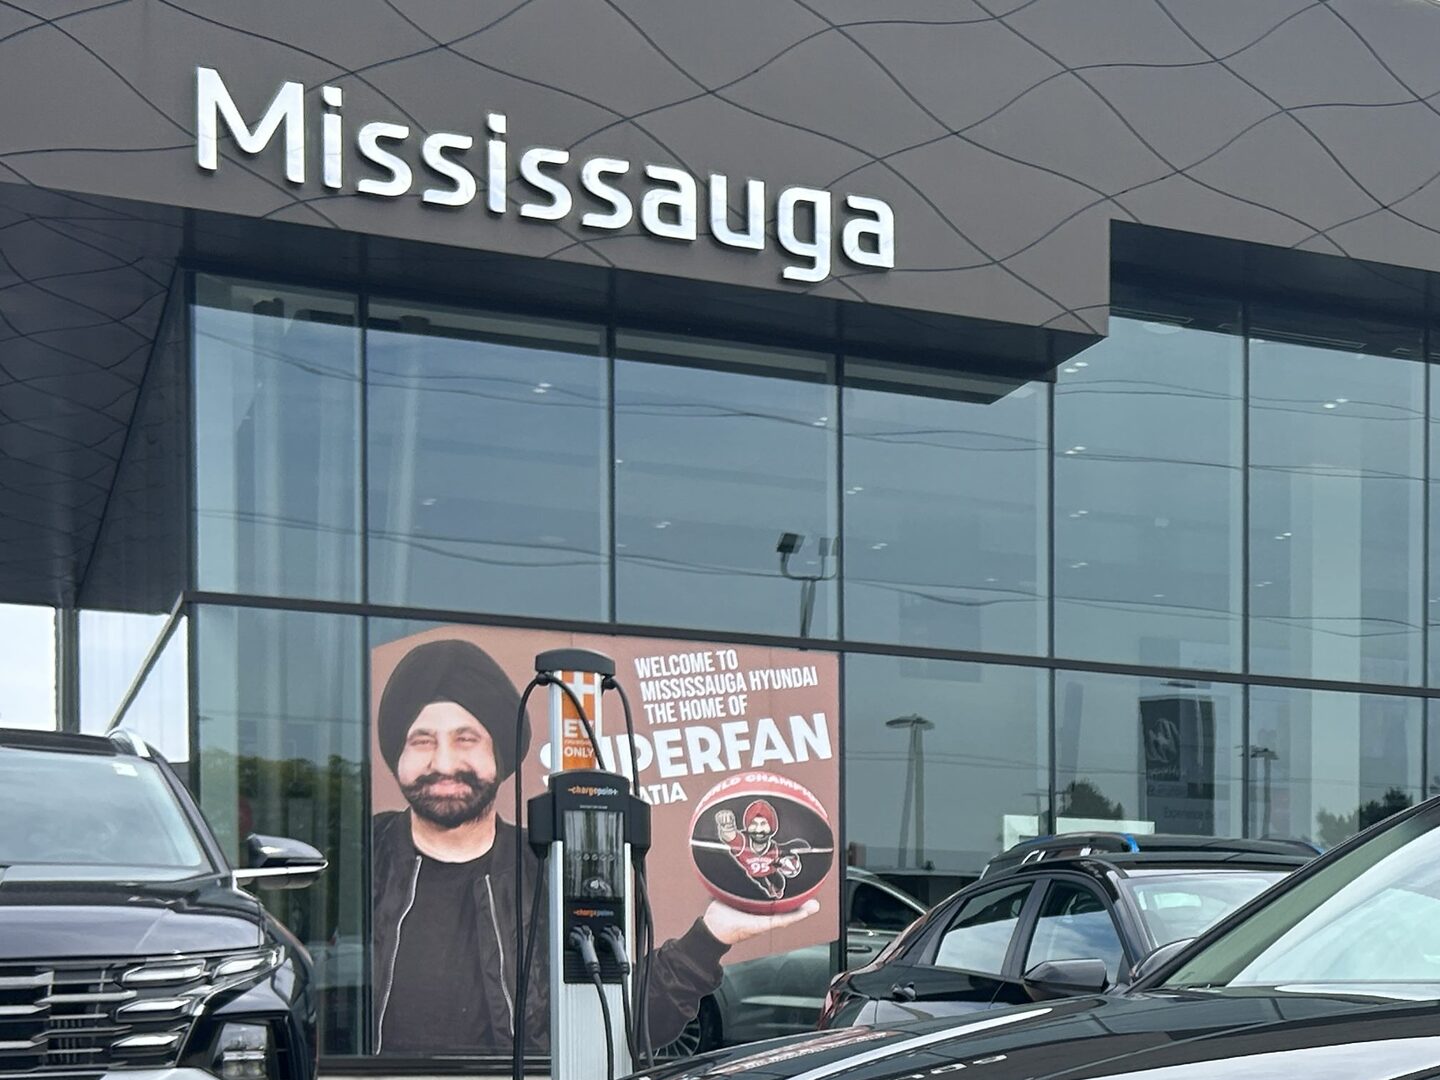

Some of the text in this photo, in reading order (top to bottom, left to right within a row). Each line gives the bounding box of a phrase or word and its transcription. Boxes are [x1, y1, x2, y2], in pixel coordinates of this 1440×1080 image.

[196, 66, 896, 284] Mississauga
[634, 649, 738, 679] WELCOME TO
[640, 665, 818, 702] MISSISSAUGA HYUNDAI
[644, 694, 748, 724] THE HOME OF
[564, 719, 595, 738] EV
[564, 746, 594, 758] ONLY
